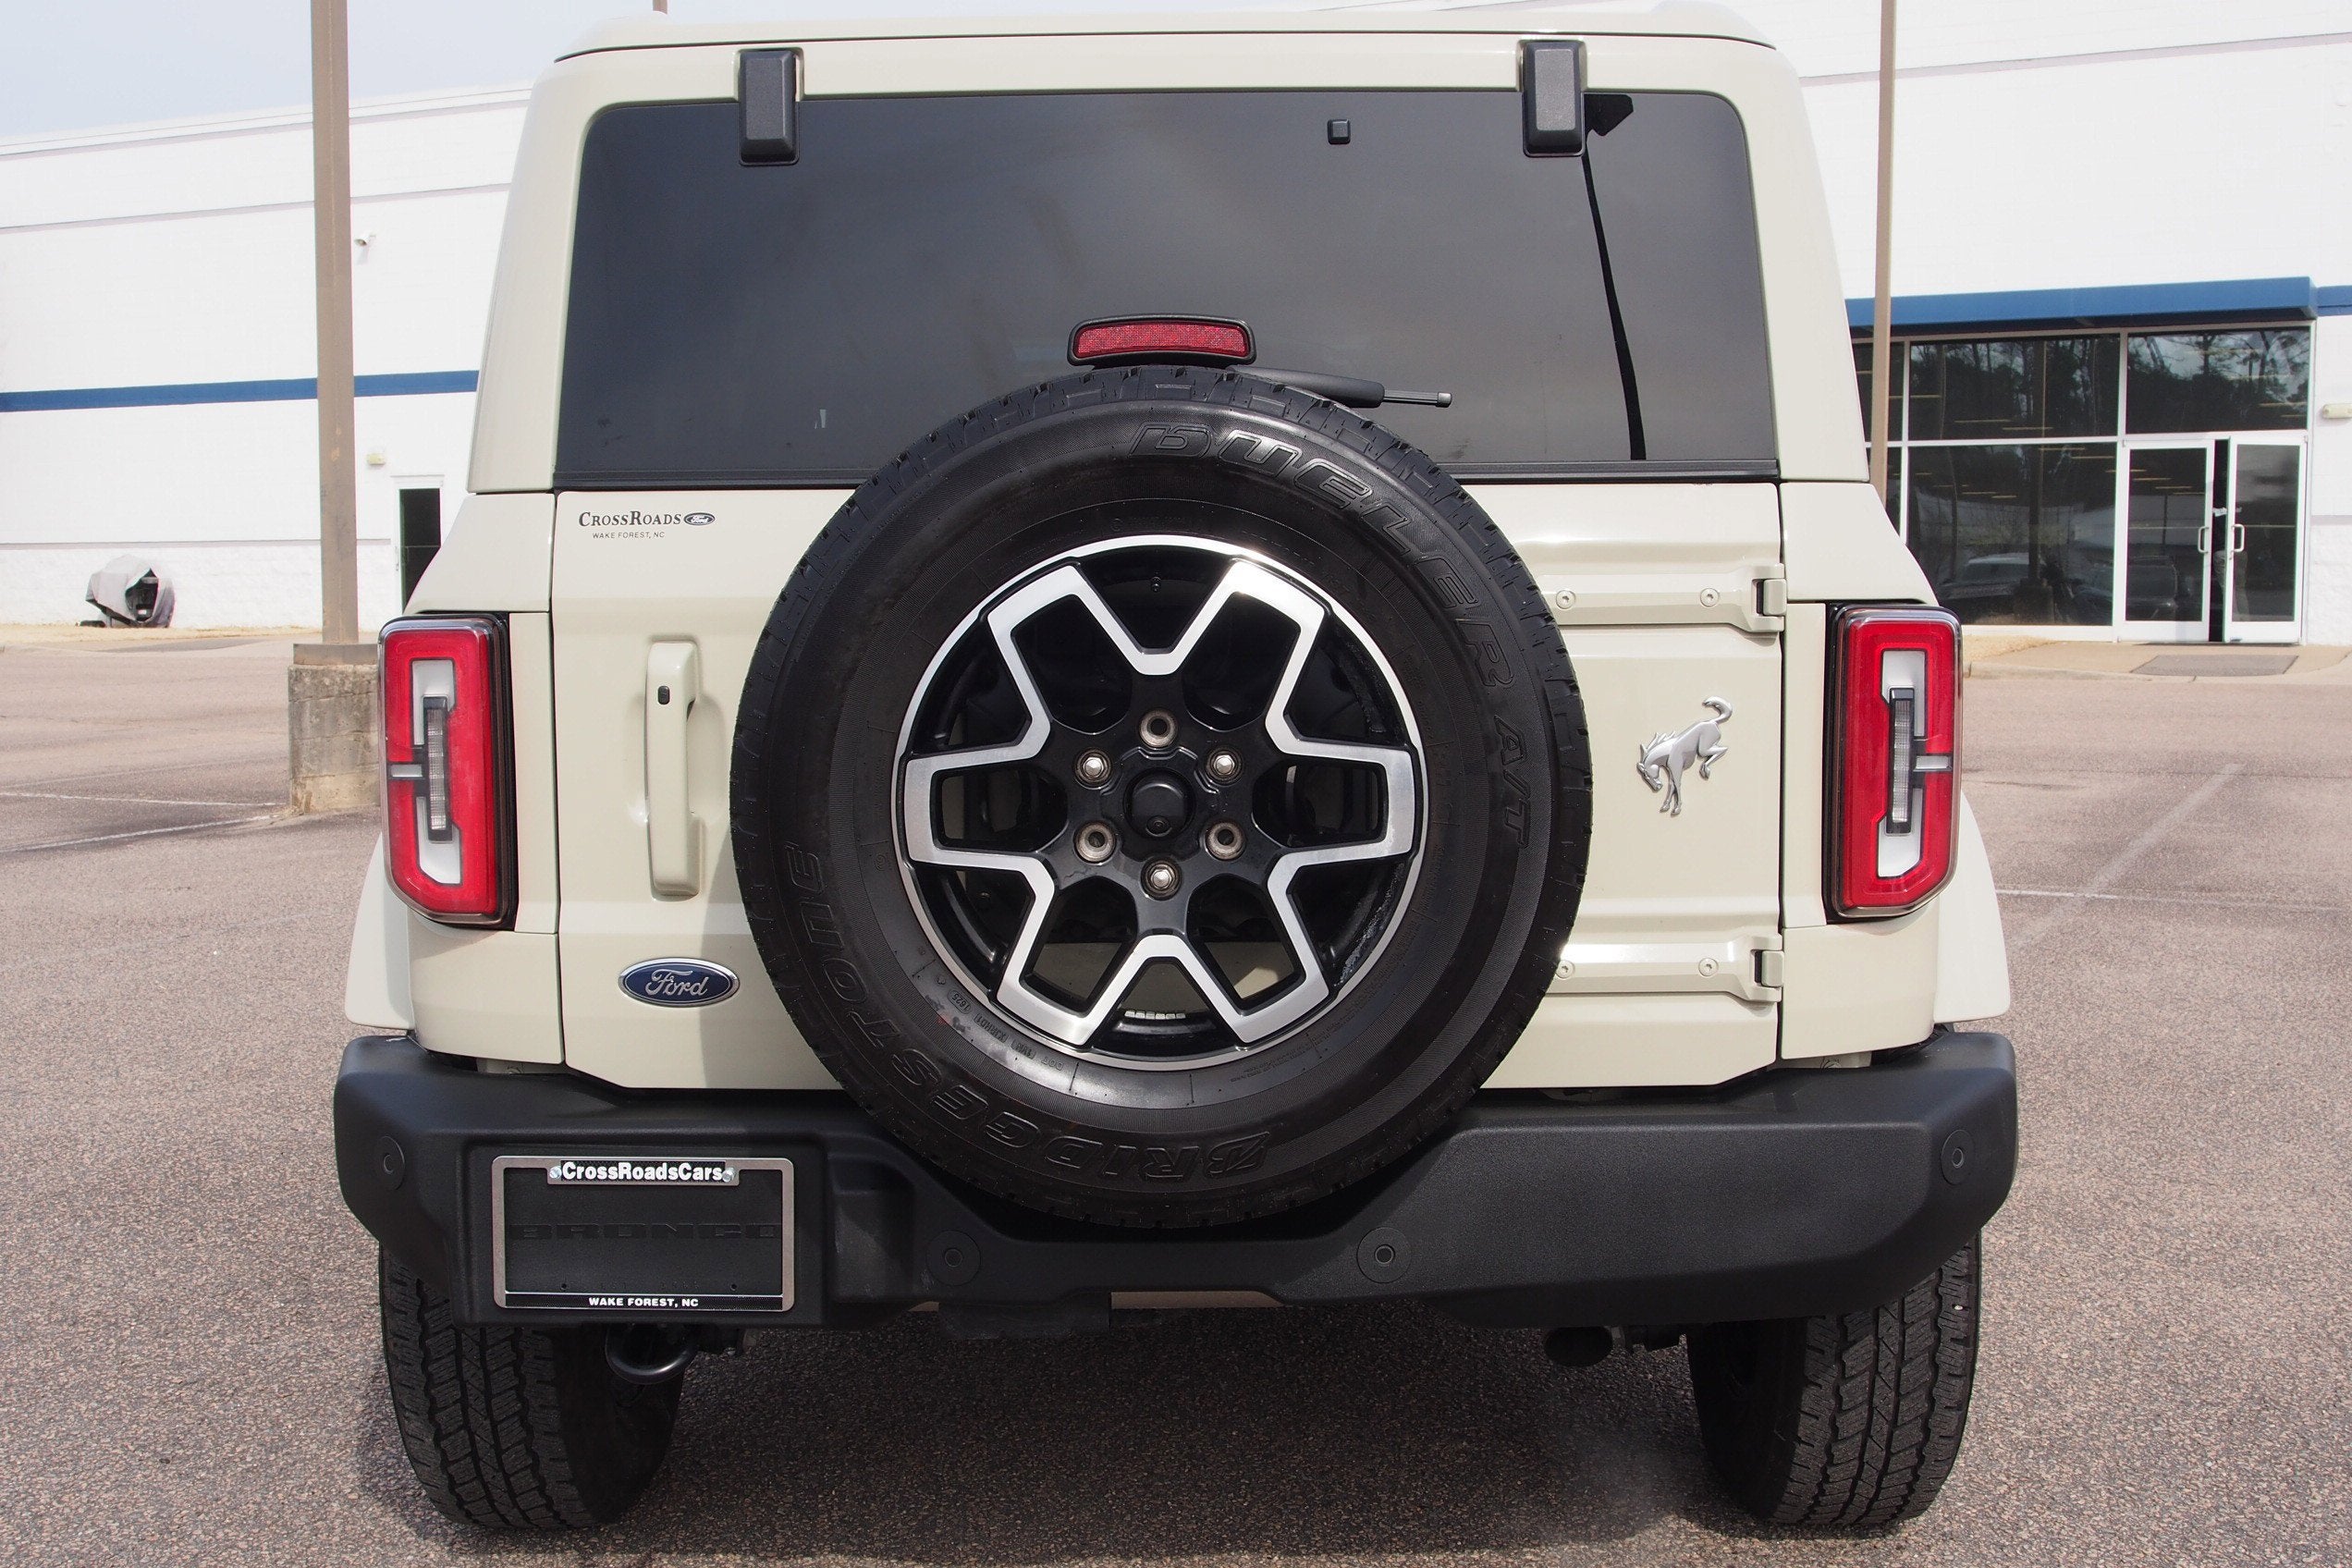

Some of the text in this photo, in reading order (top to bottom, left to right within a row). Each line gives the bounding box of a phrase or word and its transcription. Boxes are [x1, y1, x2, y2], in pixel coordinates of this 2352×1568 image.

[653, 531, 666, 539] NC
[644, 968, 709, 997] Ford
[561, 1160, 724, 1182] CrossRoadsCars
[588, 1296, 700, 1309] WAKE FOREST, NC
